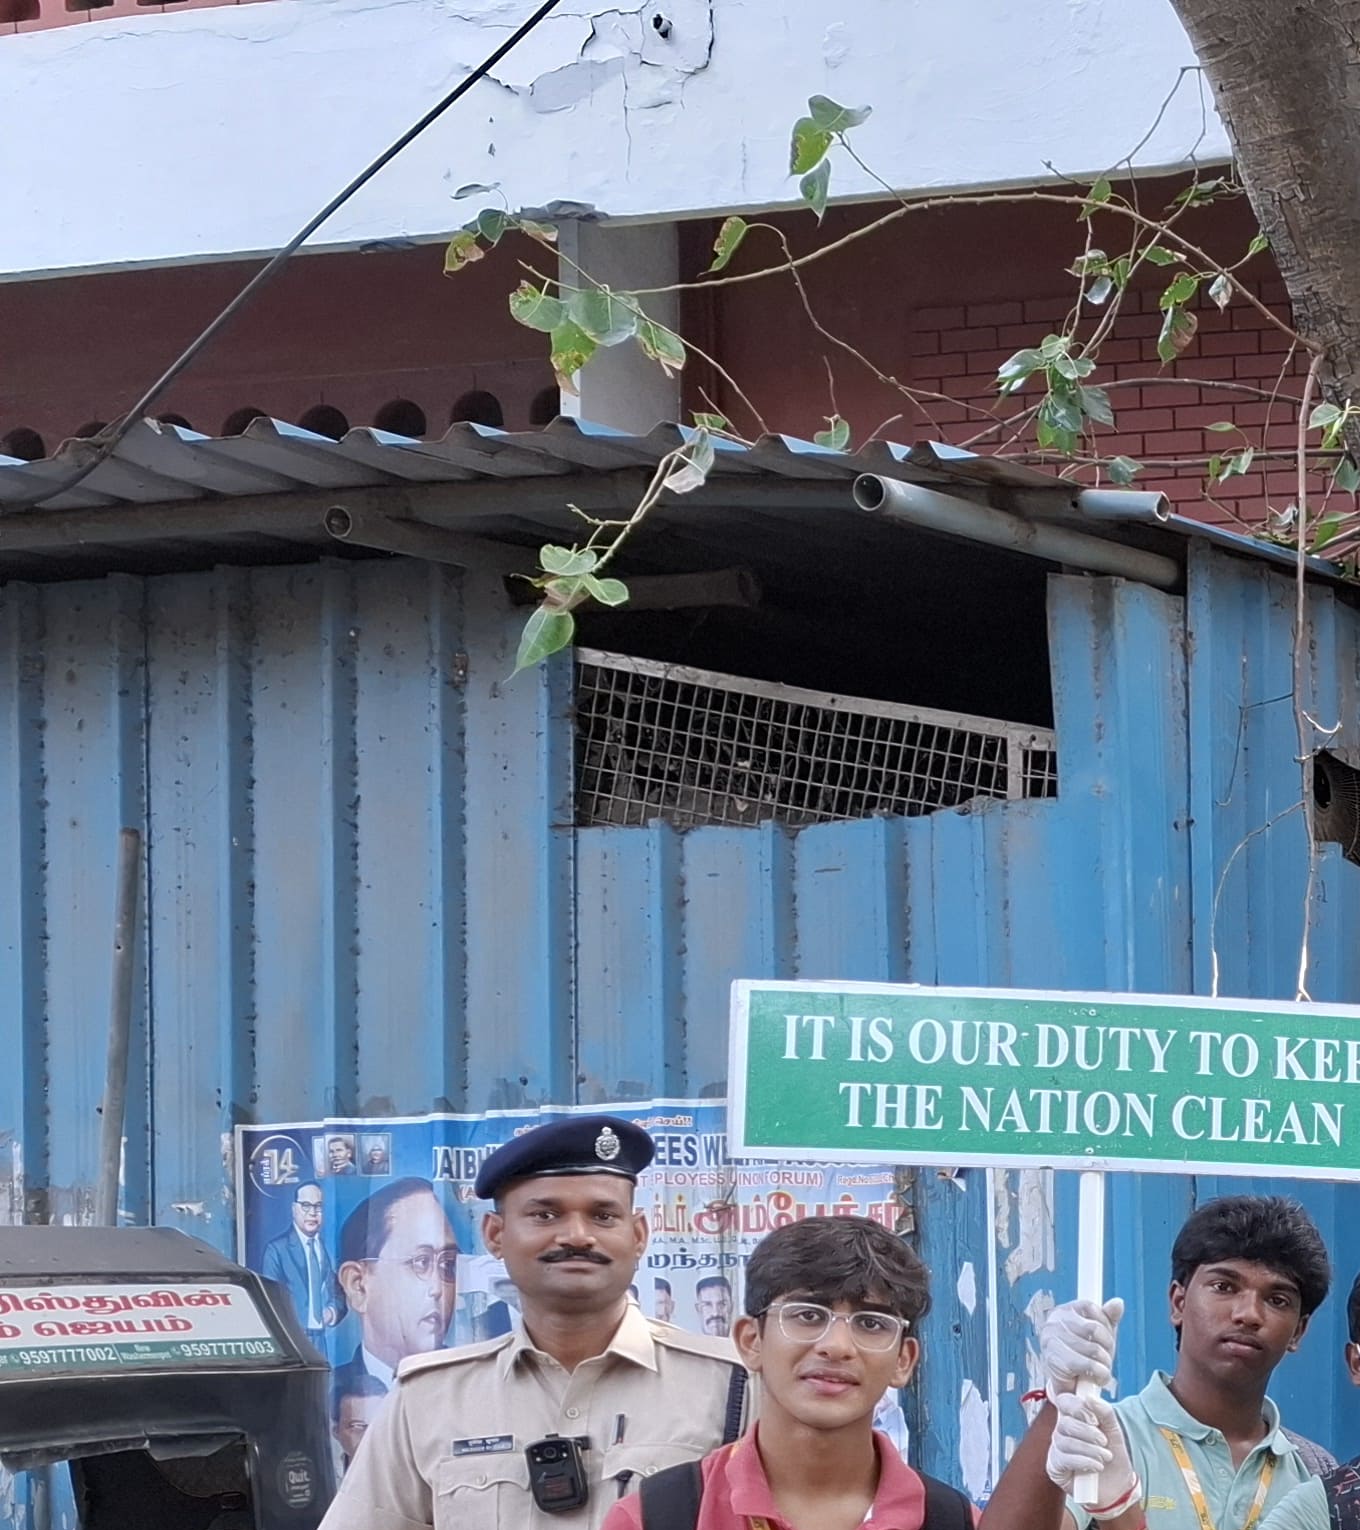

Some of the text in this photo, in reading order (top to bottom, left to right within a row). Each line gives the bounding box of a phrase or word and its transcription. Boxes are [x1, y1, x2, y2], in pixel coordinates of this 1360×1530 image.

[781, 1014, 835, 1061] IT
[845, 1014, 894, 1063] IS
[908, 1018, 1028, 1068] OUR
[1035, 1023, 1175, 1076] DUTY
[1190, 1030, 1260, 1079] TO
[838, 1081, 1346, 1148] THE NATION CLEAN
[33, 1314, 193, 1337] ஜெயம்
[20, 1346, 117, 1366] 9597777002
[182, 1341, 275, 1358] 9597777003
